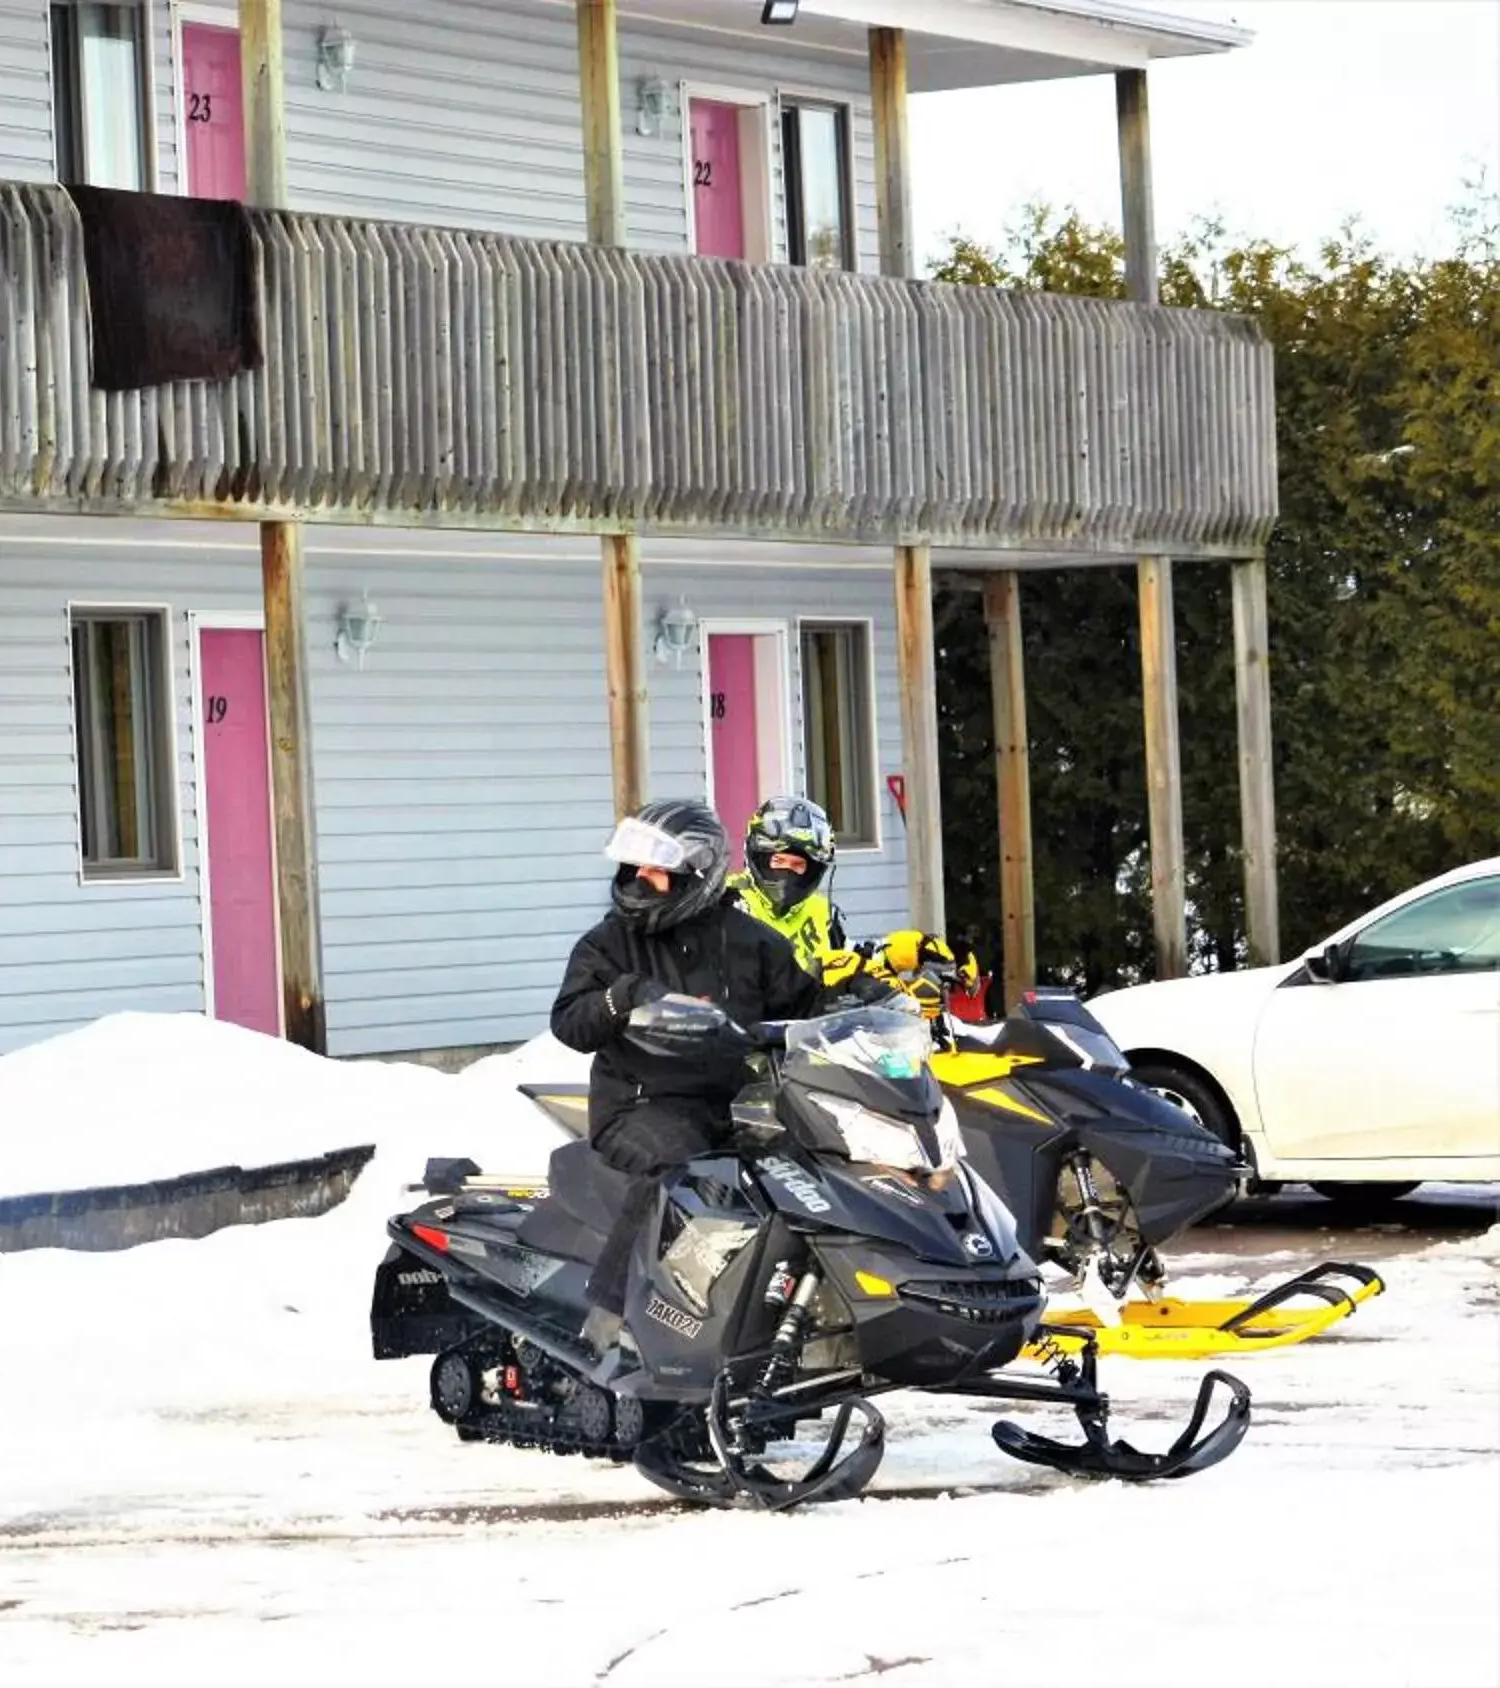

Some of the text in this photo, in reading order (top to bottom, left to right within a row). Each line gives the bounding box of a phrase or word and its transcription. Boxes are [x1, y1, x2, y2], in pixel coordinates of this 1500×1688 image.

[189, 93, 211, 122] 23
[694, 160, 712, 187] 22
[206, 696, 228, 724] 19
[711, 692, 725, 719] 18
